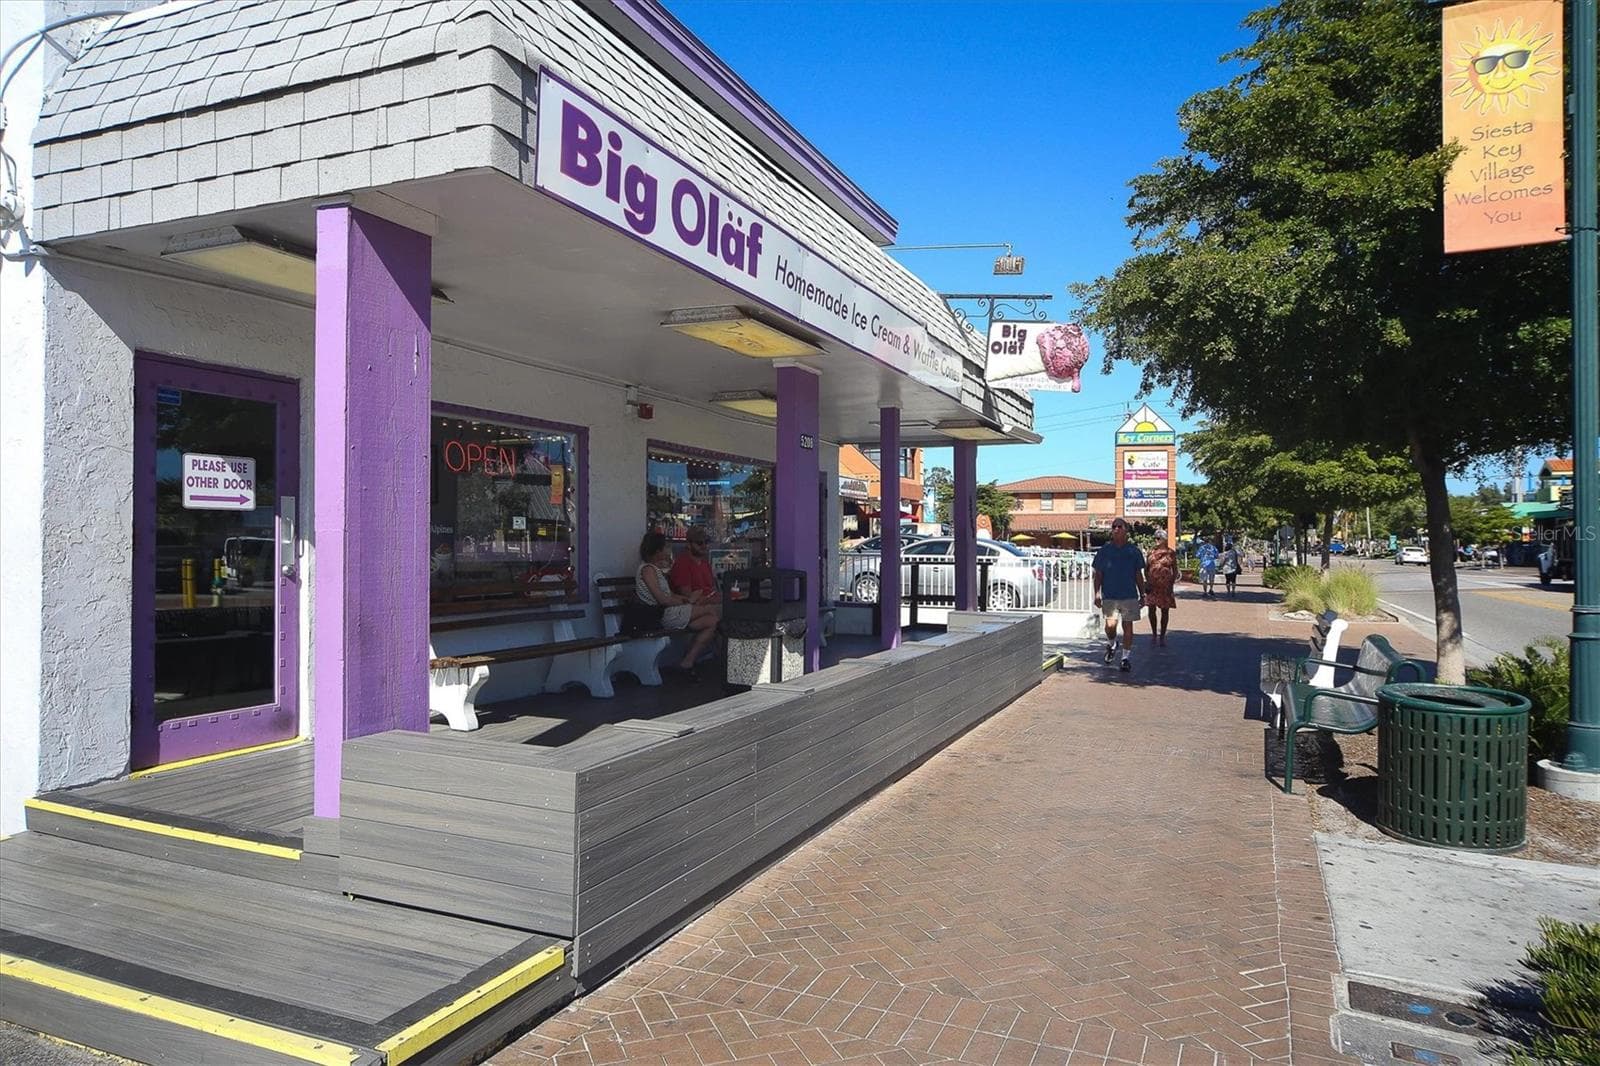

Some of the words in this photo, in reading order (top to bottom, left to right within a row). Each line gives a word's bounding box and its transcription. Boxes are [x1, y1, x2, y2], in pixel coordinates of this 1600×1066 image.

[1470, 120, 1534, 142] Siesta
[1482, 143, 1522, 163] Key
[1471, 162, 1535, 184] Village
[560, 99, 658, 235] Big
[671, 177, 763, 279] Oläf
[1454, 182, 1554, 206] Welcomes
[1484, 209, 1522, 225] You
[775, 255, 849, 322] Homemade
[851, 301, 867, 331] Ice
[870, 313, 902, 354] Cream
[903, 333, 911, 356] &
[913, 339, 939, 371] Waffle
[1002, 323, 1027, 341] Big
[991, 340, 1025, 355] Oläf
[191, 459, 226, 472] PLEASE
[231, 462, 248, 474] USE
[444, 440, 516, 479] OPEN
[186, 475, 219, 489] OTHER
[224, 478, 252, 491] DOOR
